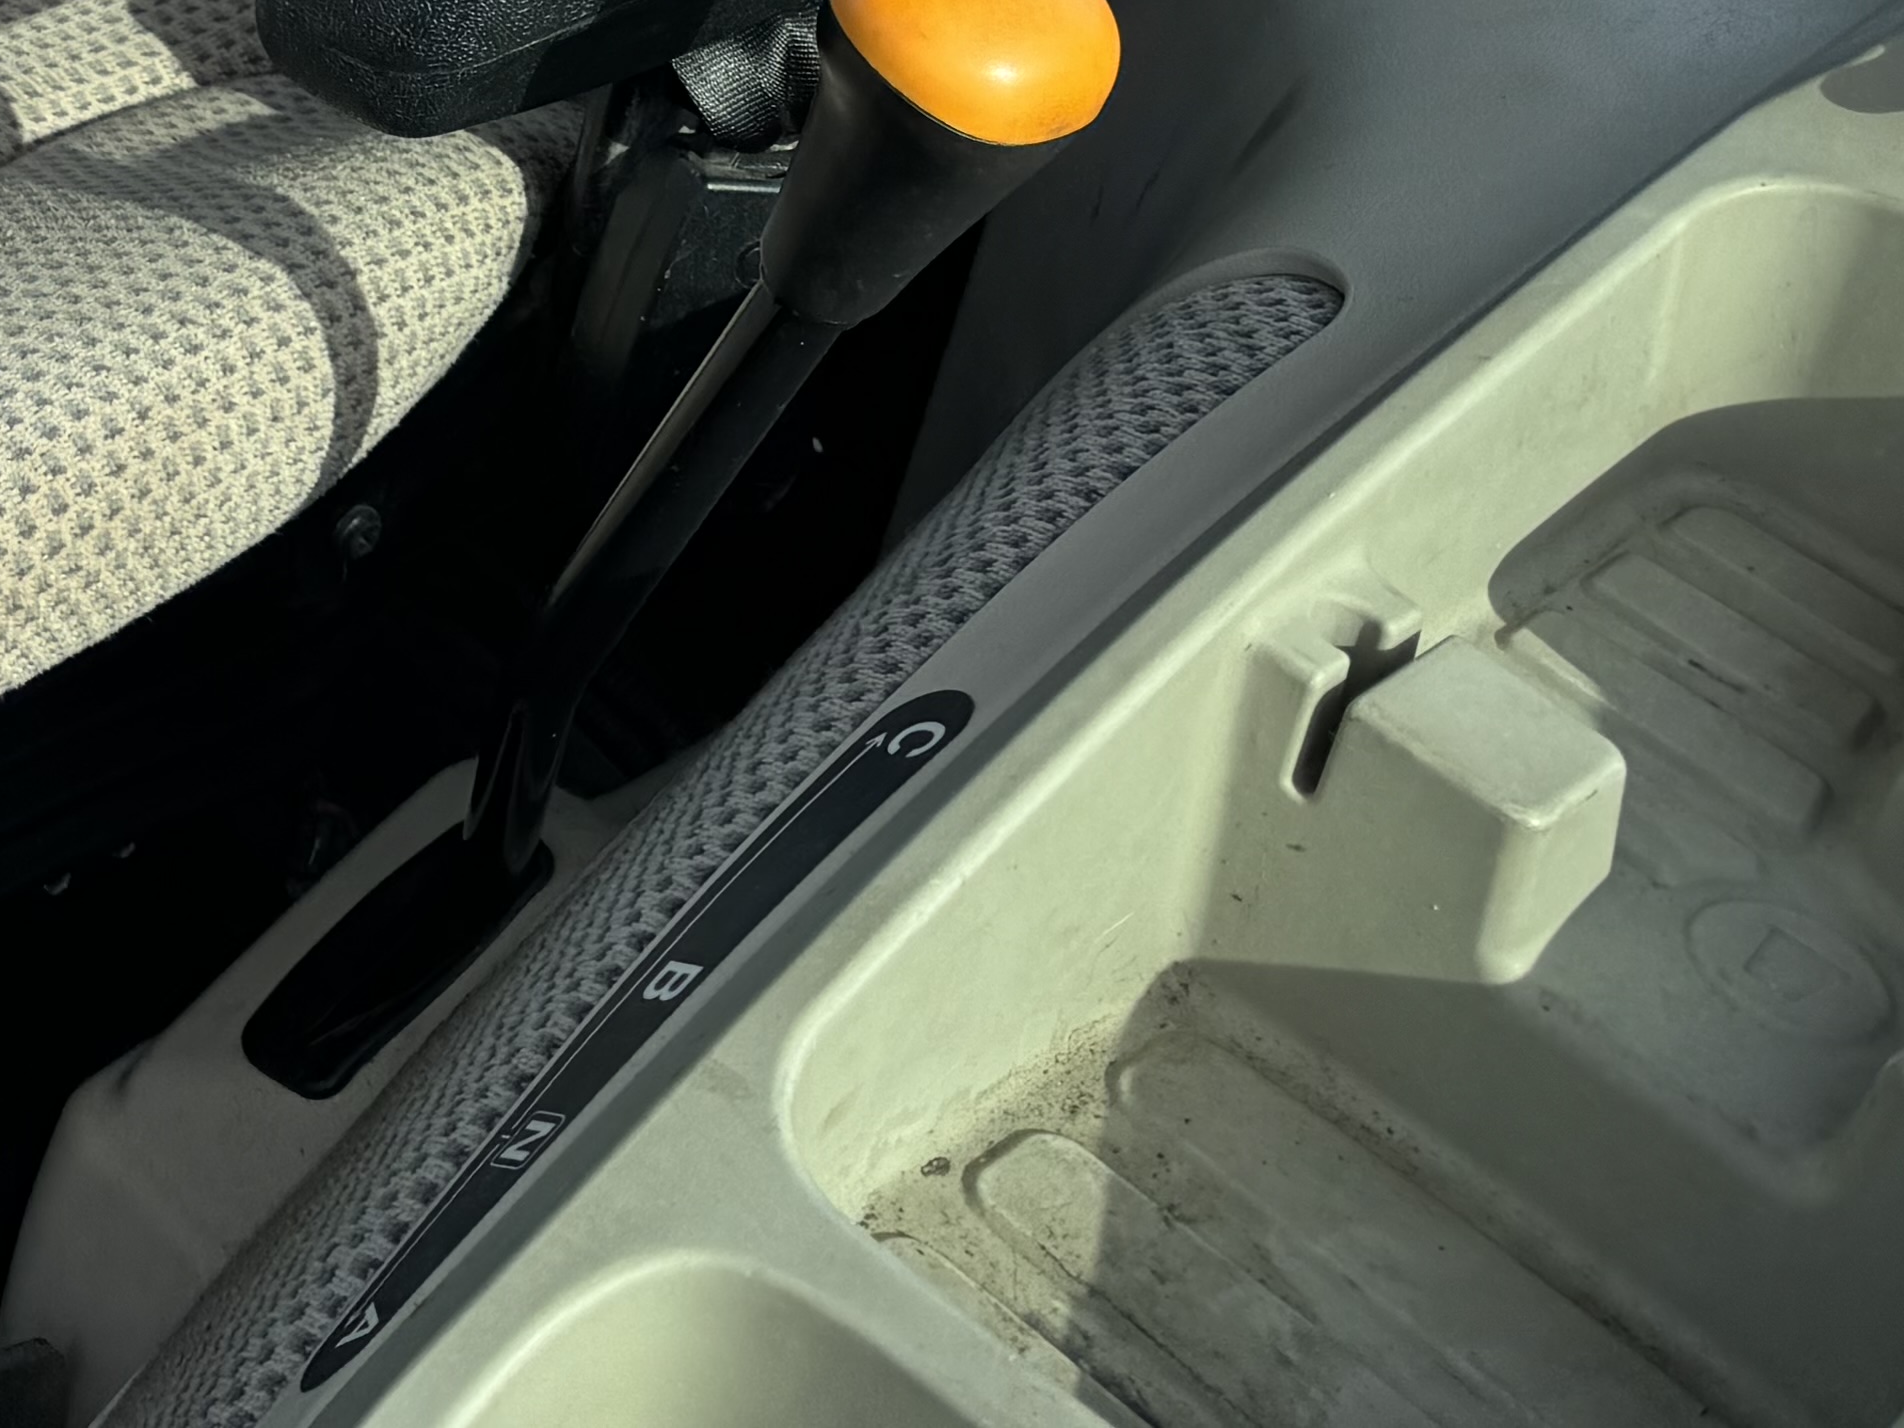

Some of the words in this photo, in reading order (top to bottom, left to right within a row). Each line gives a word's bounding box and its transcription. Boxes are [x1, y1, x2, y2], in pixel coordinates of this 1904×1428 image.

[887, 721, 945, 758] C
[642, 960, 704, 1001] B
[500, 1119, 556, 1161] N
[334, 1302, 379, 1349] A
